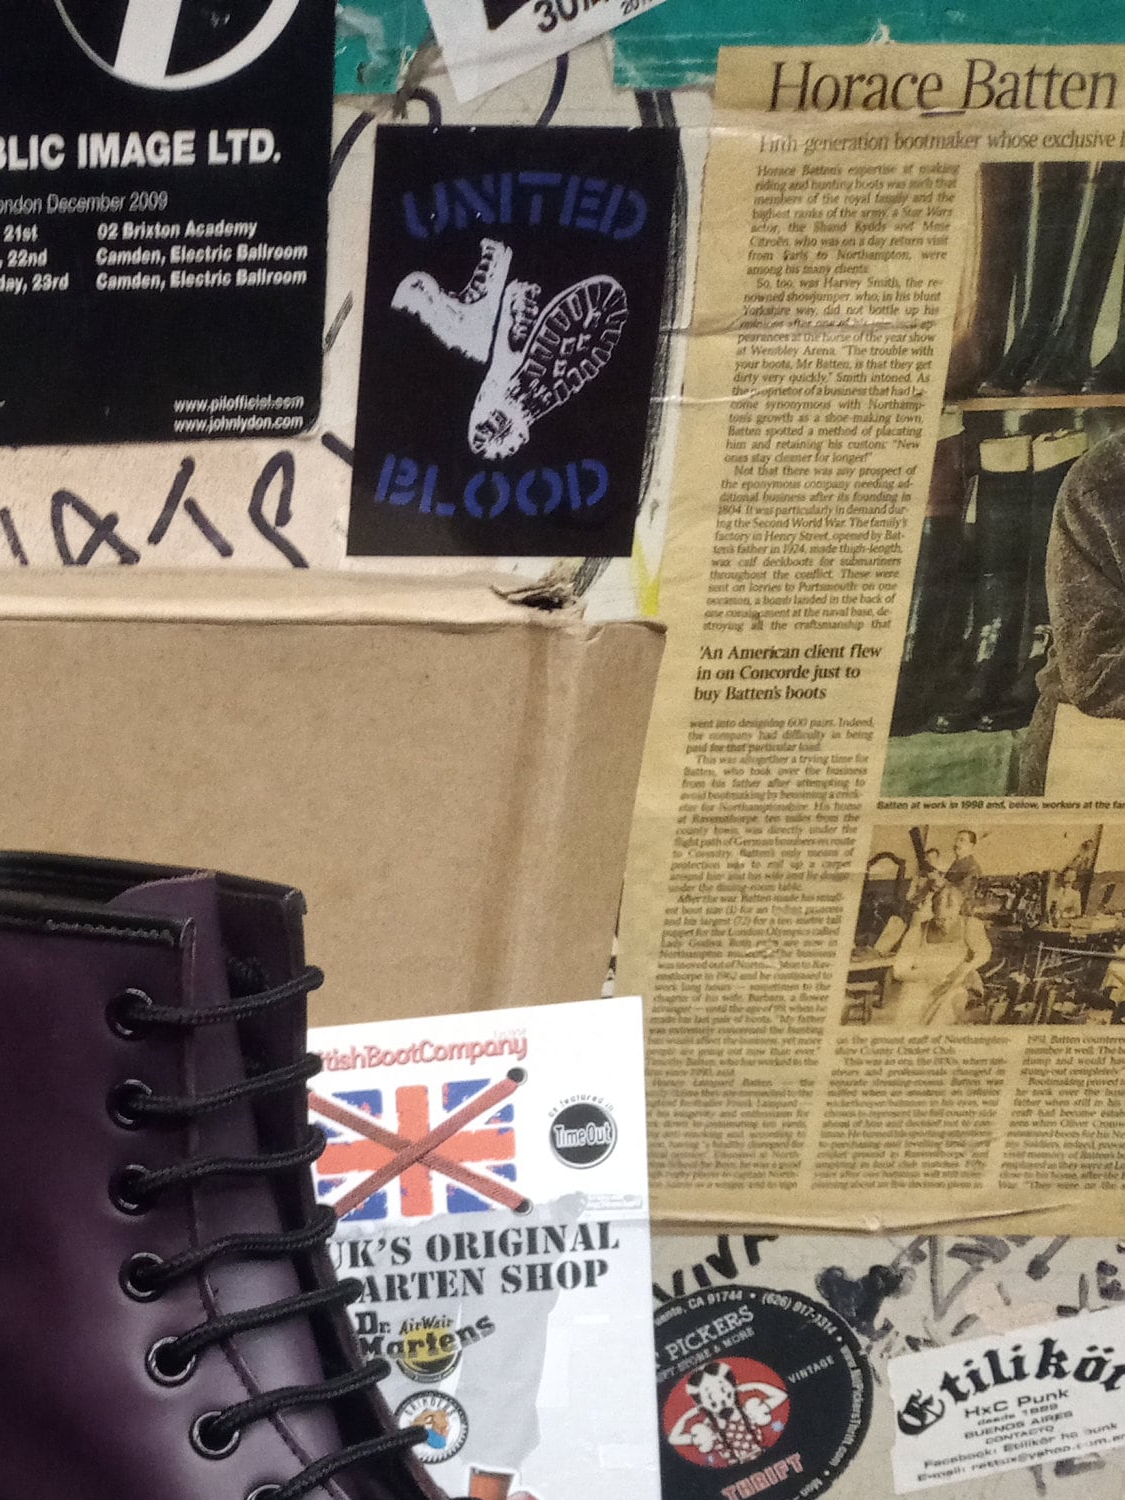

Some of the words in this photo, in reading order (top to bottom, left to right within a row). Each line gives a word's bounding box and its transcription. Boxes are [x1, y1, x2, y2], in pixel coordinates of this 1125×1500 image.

[764, 60, 942, 112] Horace
[960, 58, 1117, 110] Batten
[77, 130, 195, 170] IMAGE
[208, 128, 281, 165] LTD.
[895, 132, 981, 150] bootmaker
[987, 130, 1038, 149] whose
[1043, 129, 1116, 149] exclusive
[47, 193, 126, 214] December
[130, 191, 169, 211] 2009
[403, 171, 647, 239] UNITED
[4, 224, 38, 242] 21st
[123, 221, 180, 239] Brixton
[185, 220, 257, 239] Academy
[7, 248, 47, 266] 22nd
[96, 247, 166, 267] Camden,
[170, 245, 232, 264] Electric
[236, 244, 308, 262] Ballroom
[32, 273, 69, 291] 23rd
[96, 272, 166, 291] Camden,
[170, 271, 232, 289] Electric
[236, 269, 308, 287] Ballroom
[174, 415, 303, 434] www.johnlydon.com
[376, 453, 608, 518] BLOOD
[727, 645, 799, 660] American
[804, 644, 844, 659] client
[849, 643, 882, 658] flew
[697, 666, 711, 681] in
[715, 667, 734, 680] on
[739, 665, 809, 680] Concorde
[811, 664, 840, 683] just
[845, 666, 861, 679] to
[694, 686, 720, 704] buy
[725, 685, 781, 701] Batten's
[785, 684, 826, 700] boots
[319, 1036, 528, 1071] tishBootCompany
[426, 1221, 620, 1263] ORIGINAL
[359, 1267, 486, 1303] ARTEN
[501, 1259, 609, 1294] SHOP
[688, 1297, 705, 1309] CA
[355, 1311, 391, 1336] Dr.
[399, 1315, 454, 1335] AirWair
[665, 1304, 754, 1361] PICKERS
[359, 1315, 496, 1359] Martens
[722, 1326, 756, 1347] MORE
[787, 1355, 836, 1384] VINTAGE
[964, 1400, 1010, 1418] HxC
[1017, 1389, 1069, 1407] Punk
[964, 1422, 1025, 1439] BUENOS
[1031, 1410, 1074, 1425] AIRES
[985, 1425, 1055, 1444] CONTACTO
